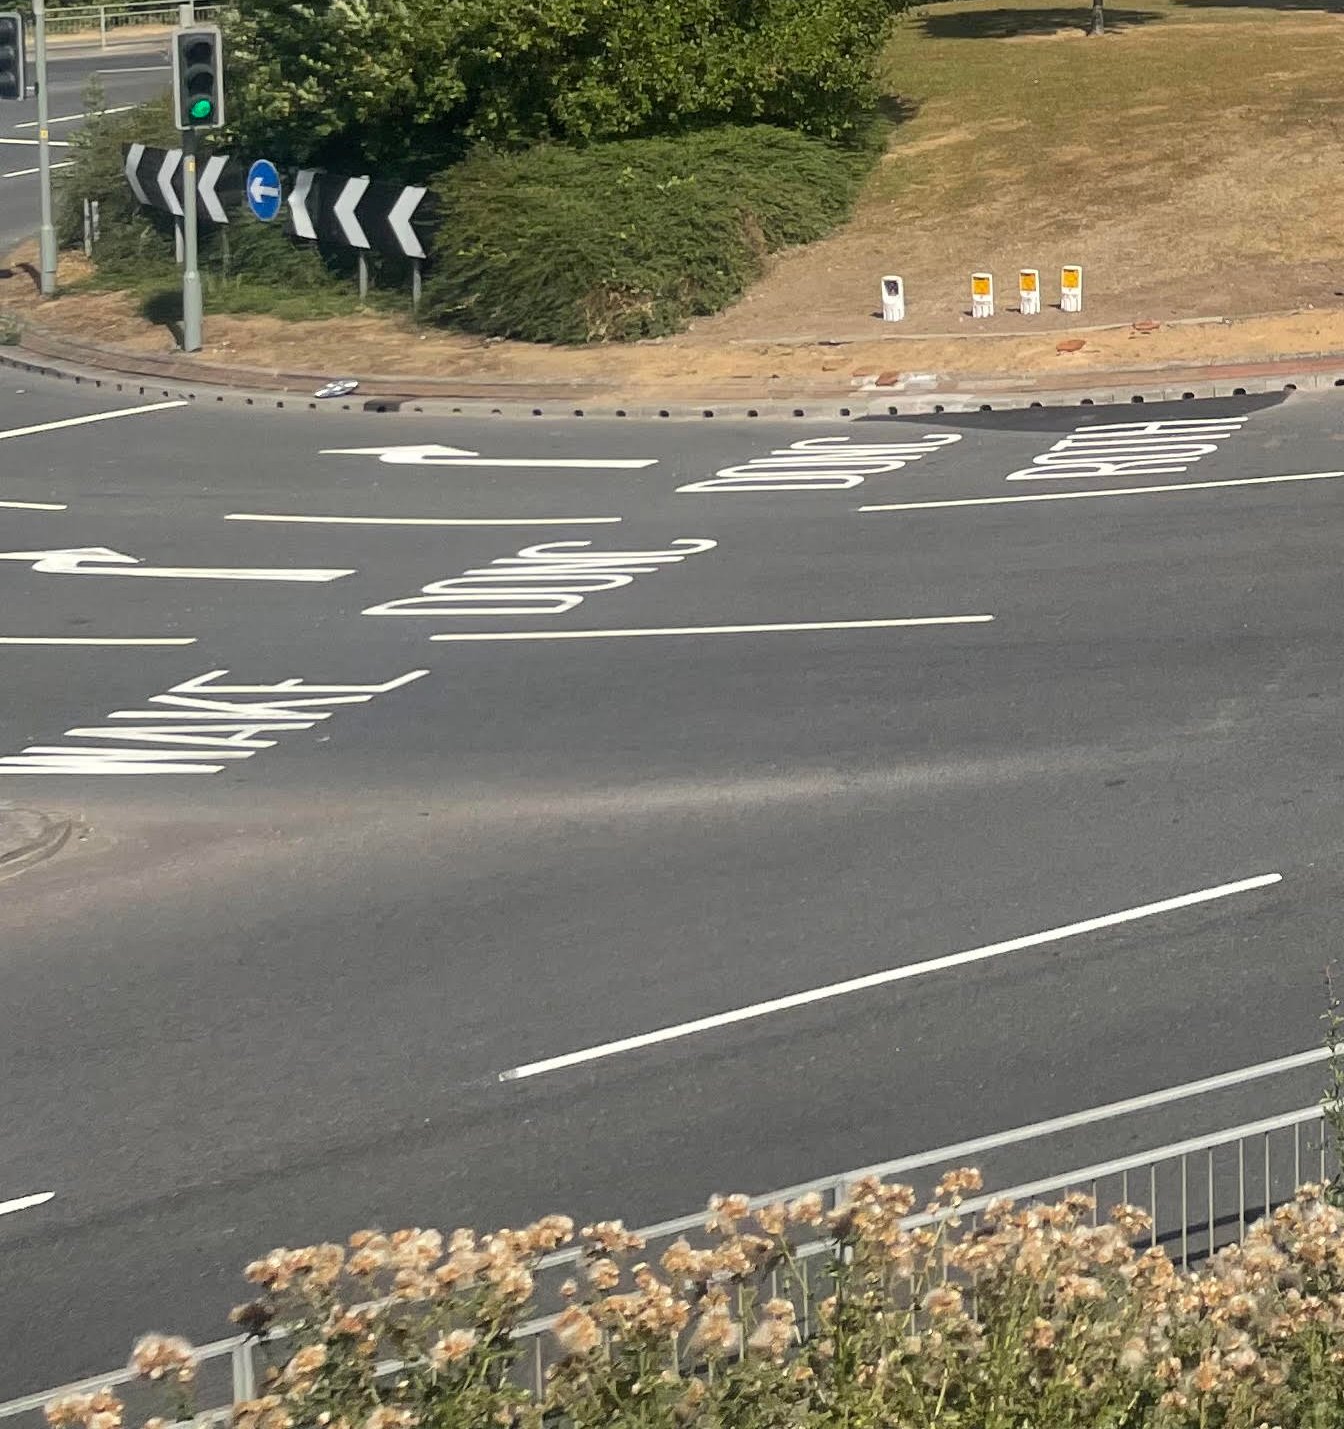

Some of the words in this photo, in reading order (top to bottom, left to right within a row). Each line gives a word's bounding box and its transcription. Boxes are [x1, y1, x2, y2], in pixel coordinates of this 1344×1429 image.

[675, 434, 962, 492] DONC
[1006, 416, 1249, 481] ROTH
[361, 538, 718, 615] DONC
[0, 670, 430, 774] WAKE
